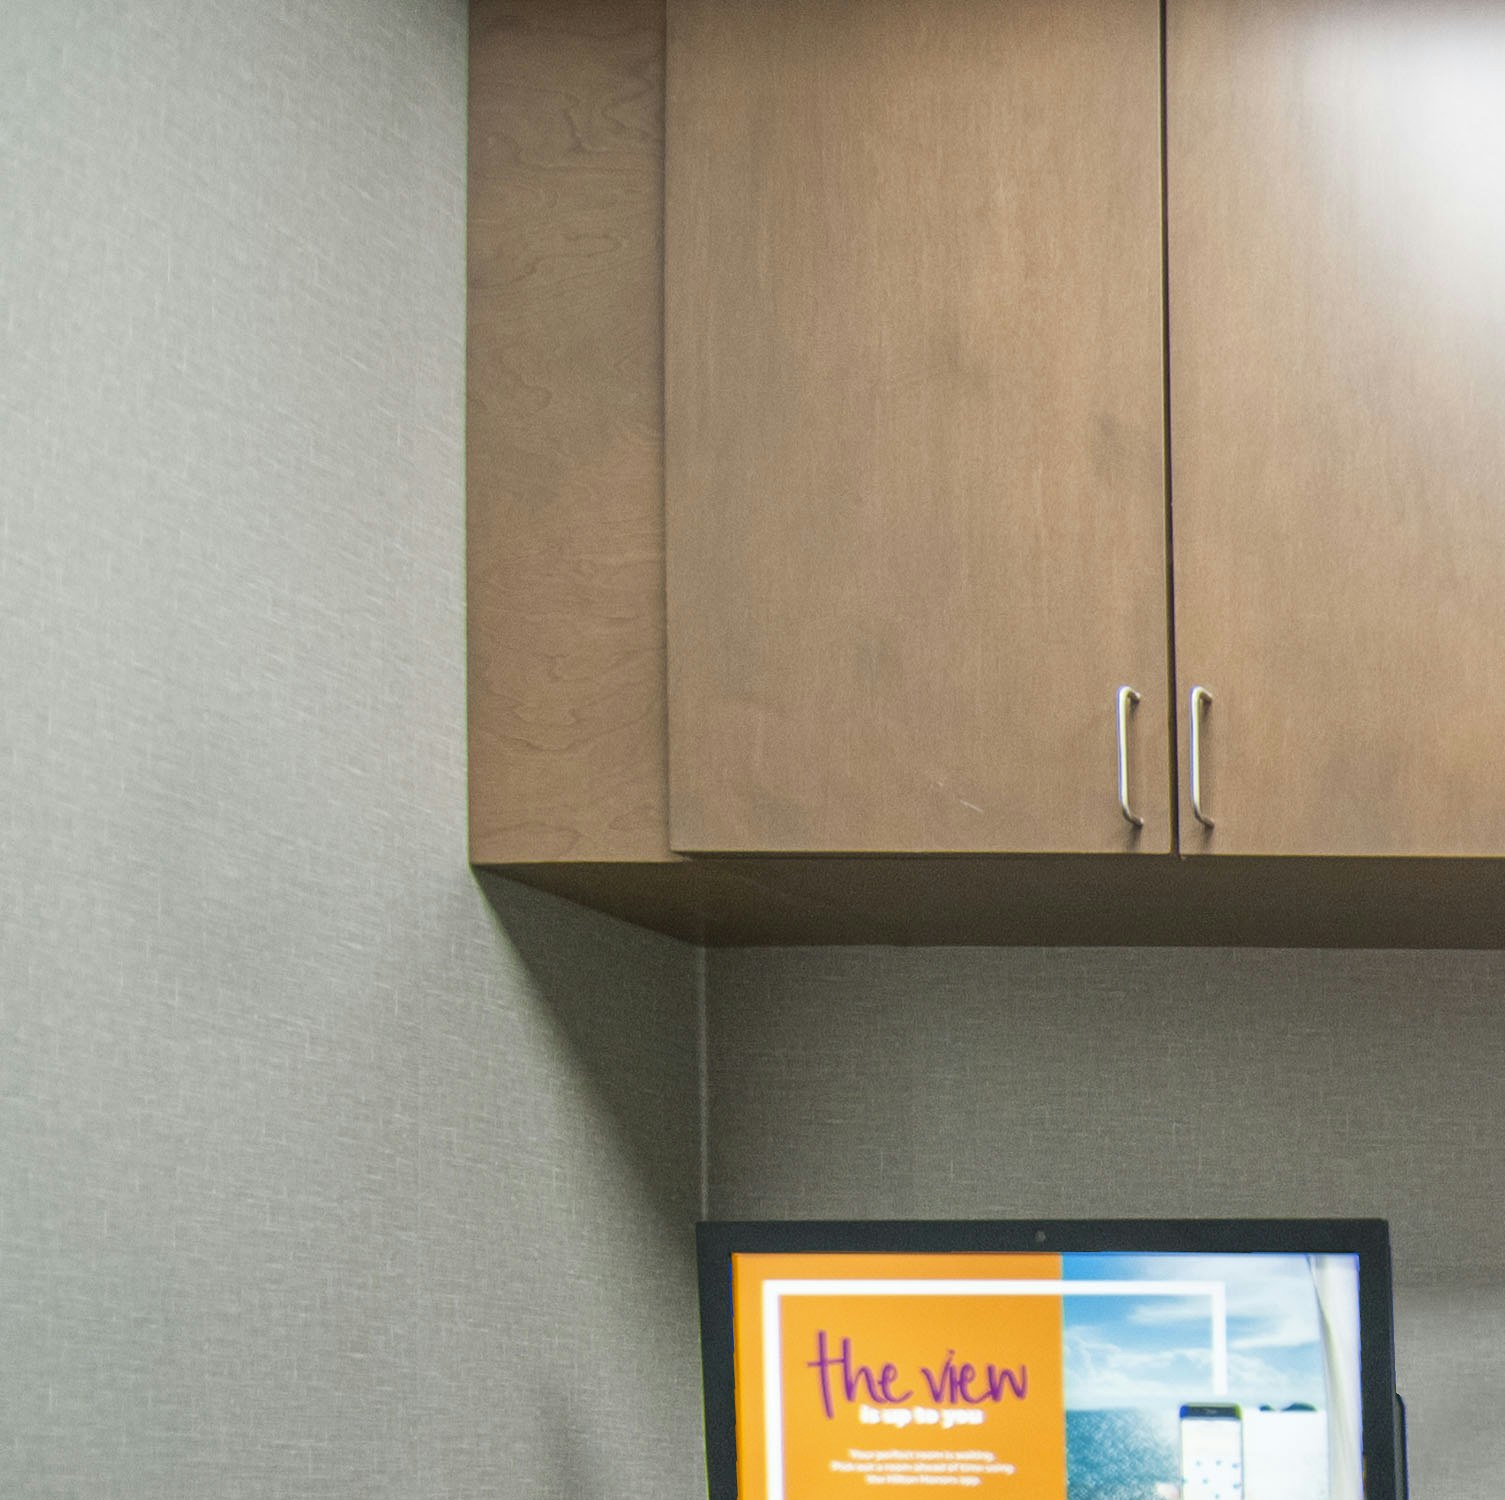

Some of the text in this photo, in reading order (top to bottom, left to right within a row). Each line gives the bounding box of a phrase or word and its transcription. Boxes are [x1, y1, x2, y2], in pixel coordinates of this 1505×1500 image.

[806, 1329, 1029, 1420] the view
[859, 1403, 986, 1429] is up to you
